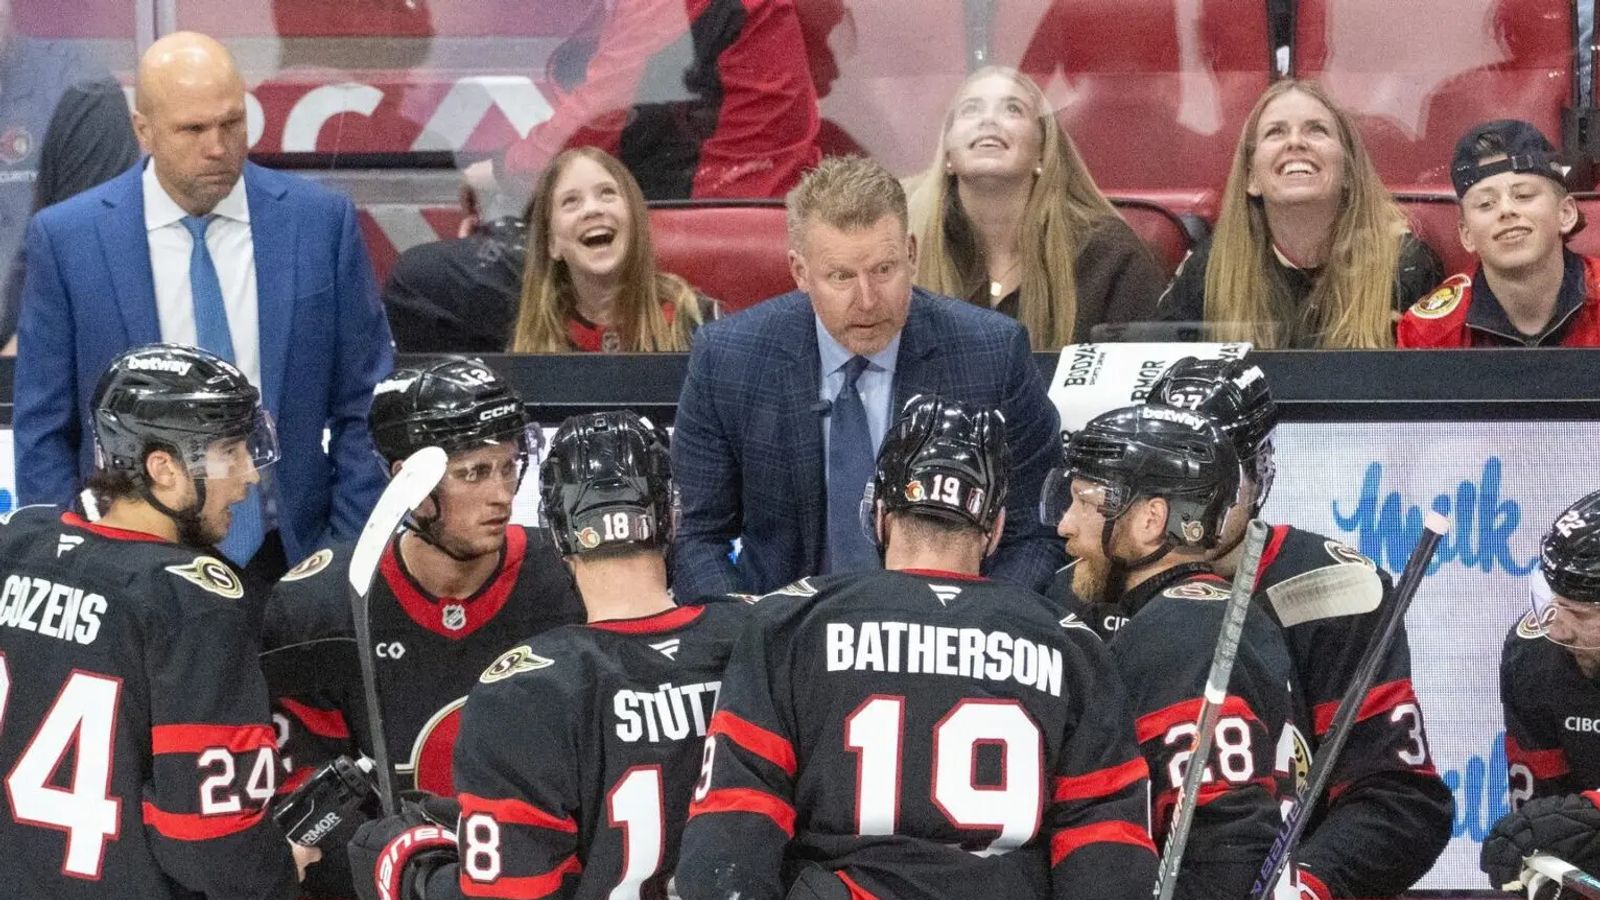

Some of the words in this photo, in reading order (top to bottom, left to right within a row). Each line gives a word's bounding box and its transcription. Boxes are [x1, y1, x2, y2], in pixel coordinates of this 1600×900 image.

[128, 357, 193, 376] betway
[479, 404, 516, 421] CCM
[1143, 407, 1206, 430] betway
[930, 474, 960, 507] 19
[603, 512, 629, 541] 18
[0, 574, 108, 645] COZENS
[826, 622, 1062, 697] BATHERSON
[1164, 717, 1254, 788] 28
[199, 747, 275, 815] 24
[845, 694, 1044, 858] 19
[300, 811, 340, 846] RMOR
